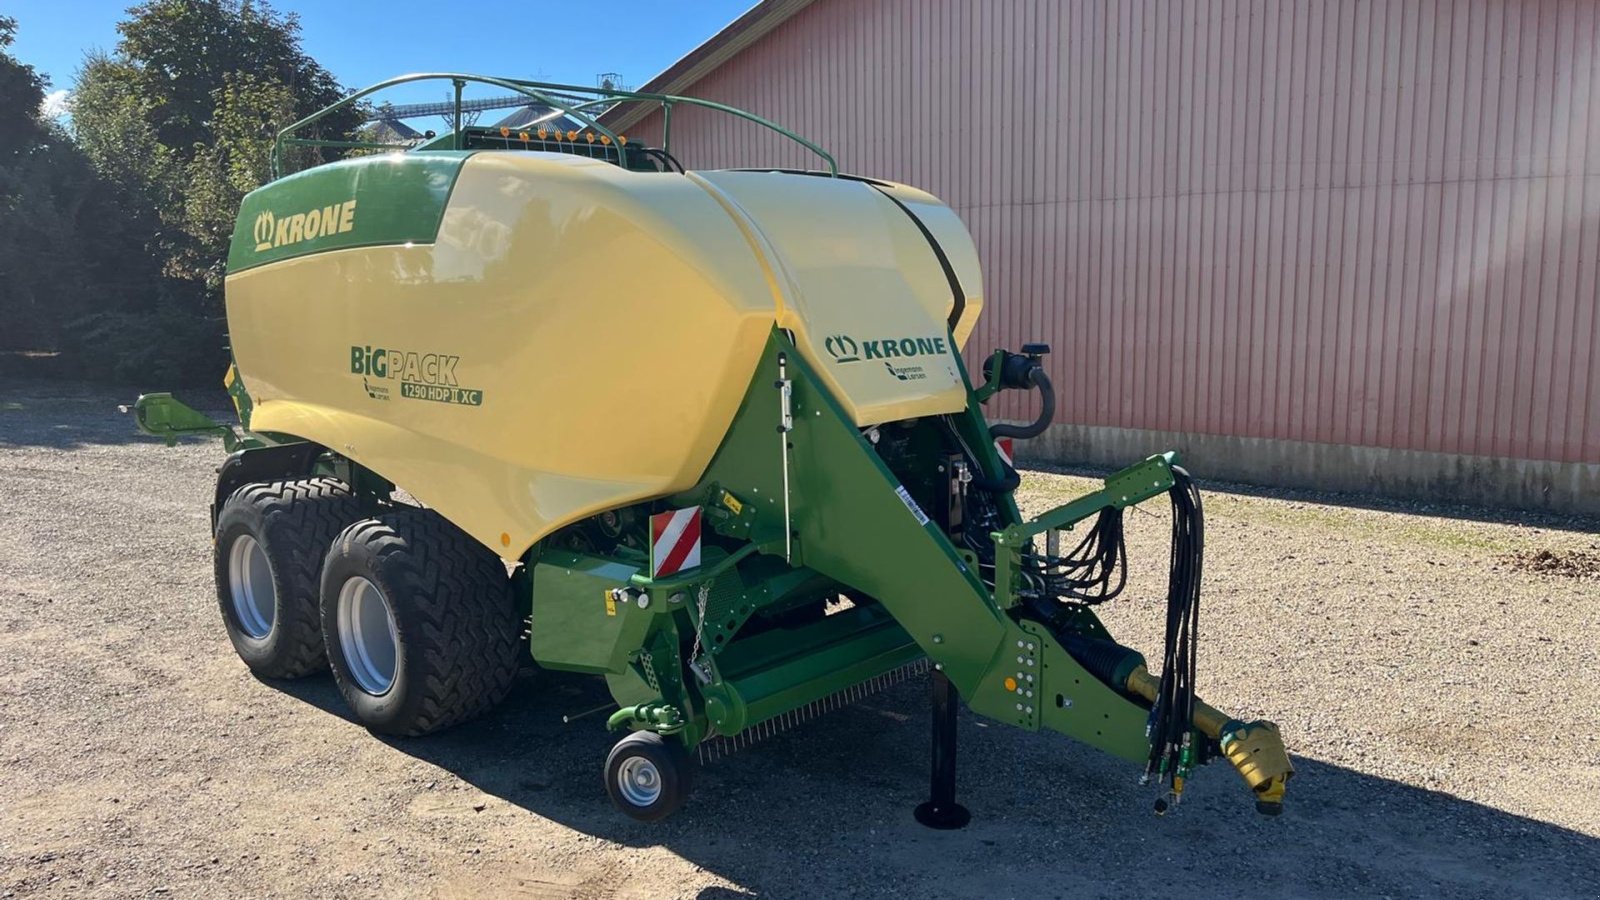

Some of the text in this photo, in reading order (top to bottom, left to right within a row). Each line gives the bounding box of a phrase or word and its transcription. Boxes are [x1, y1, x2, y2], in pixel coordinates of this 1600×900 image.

[274, 200, 357, 248] KRONE
[863, 338, 947, 360] KRONE
[404, 384, 427, 399] 1290
[461, 390, 478, 405] XC
